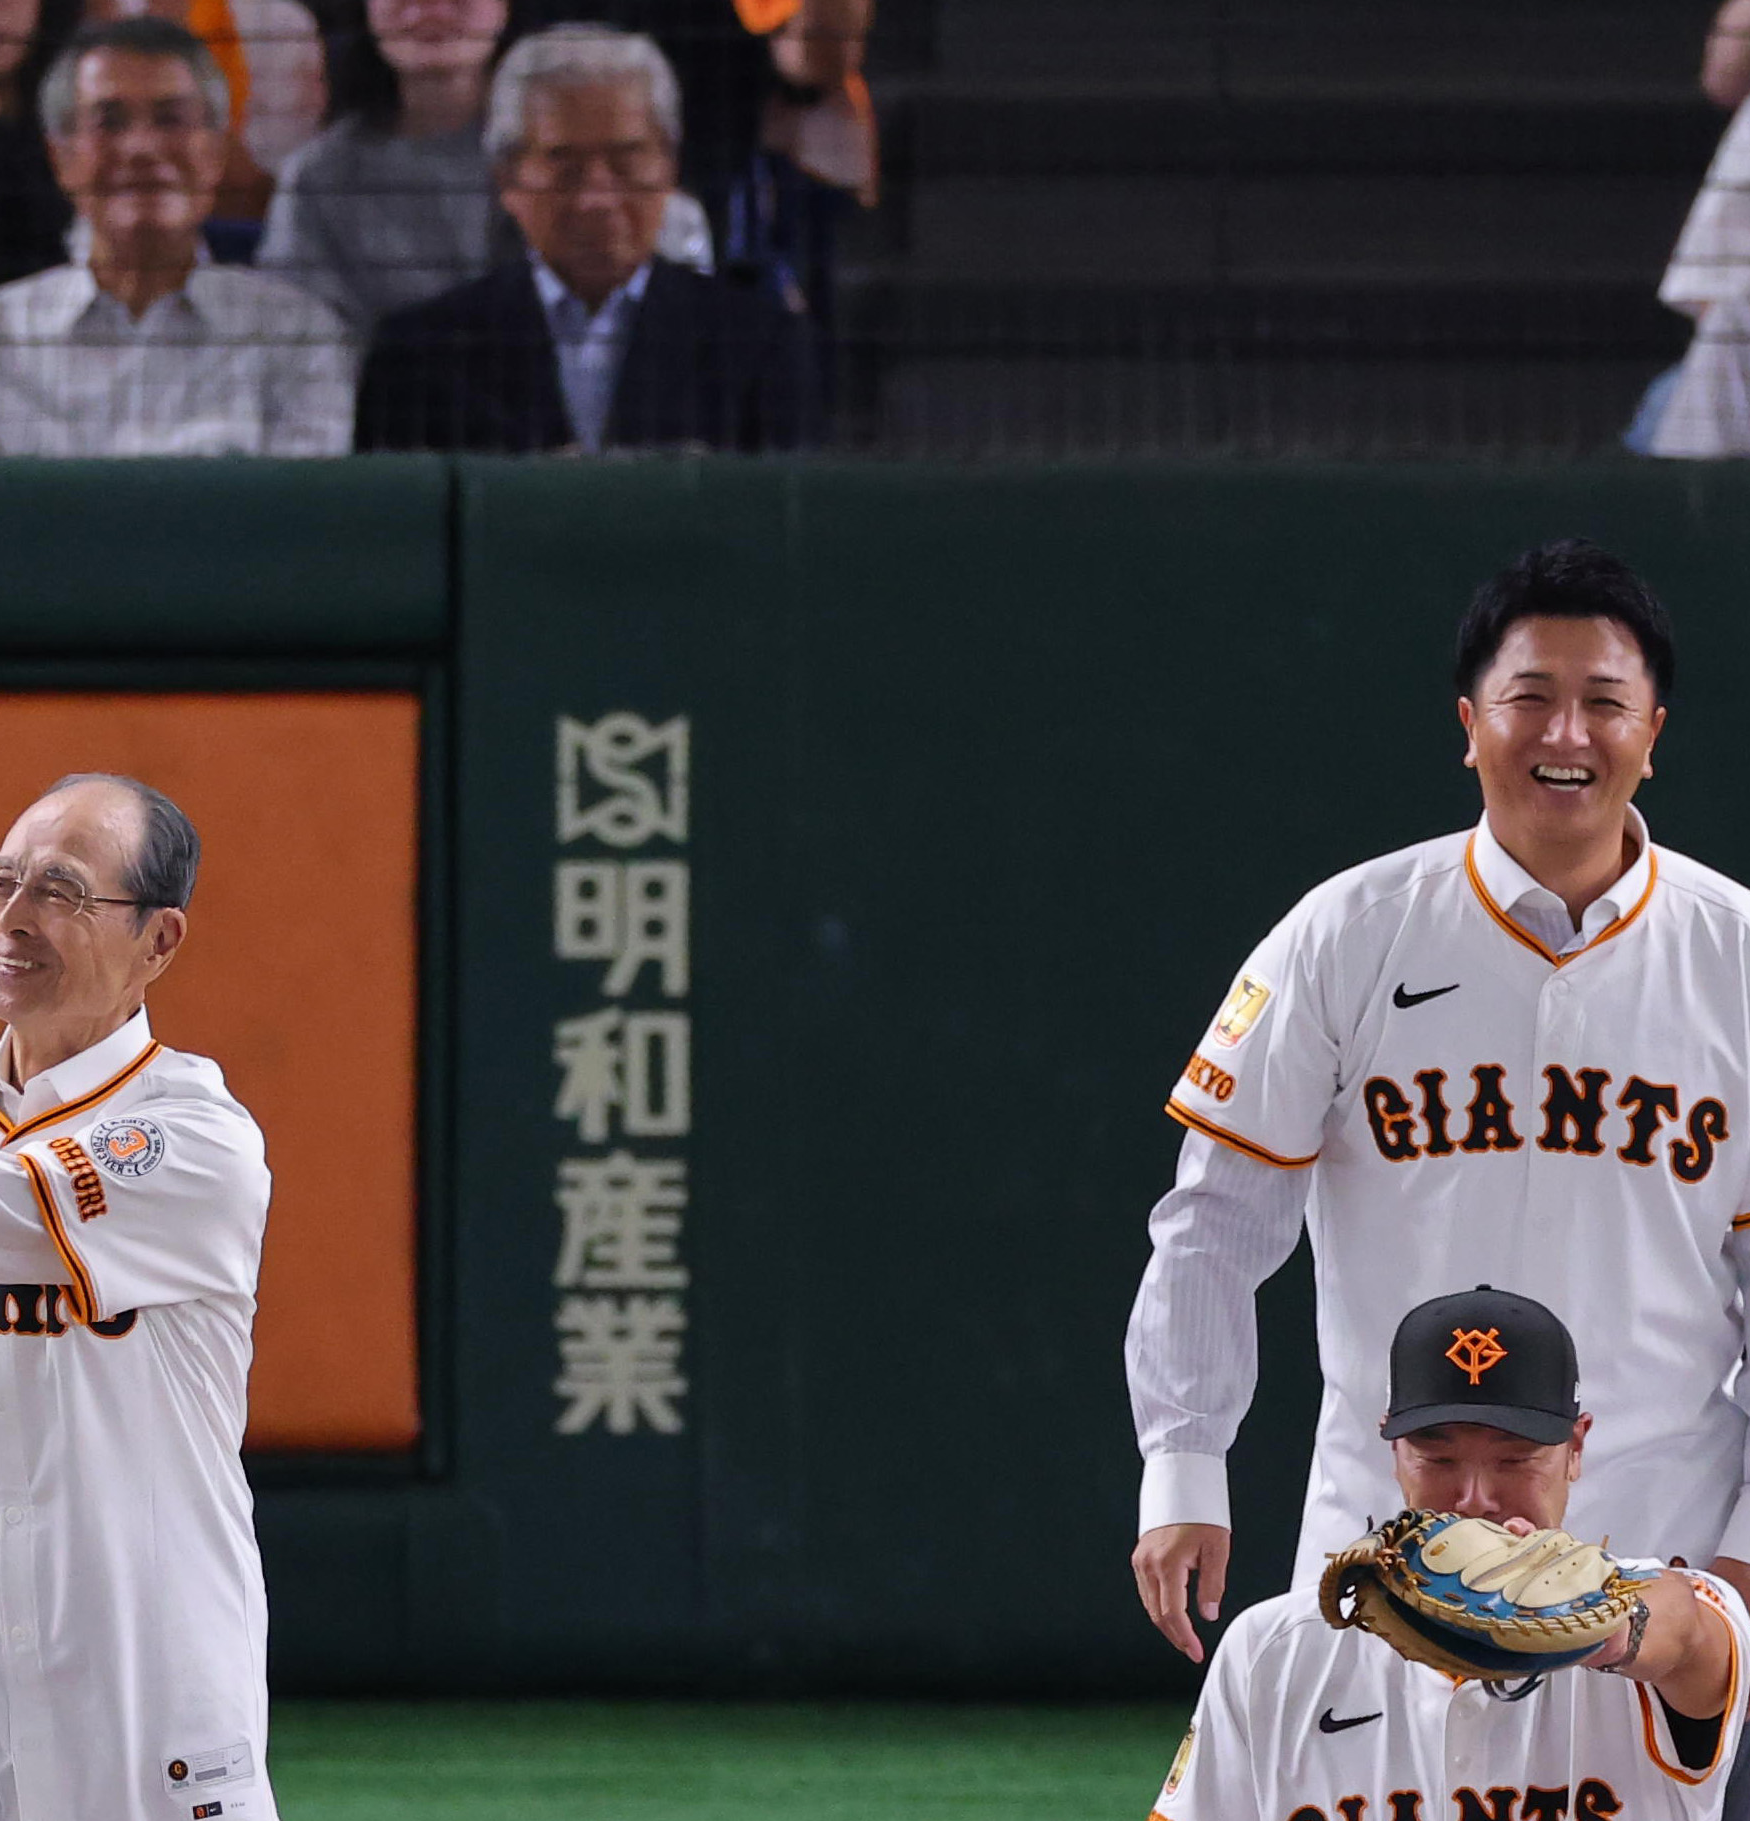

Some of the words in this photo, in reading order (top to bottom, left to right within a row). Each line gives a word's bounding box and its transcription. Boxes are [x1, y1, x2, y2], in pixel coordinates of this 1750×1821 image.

[555, 860, 690, 1434] 明和産業
[1363, 1063, 1729, 1184] GIANTS
